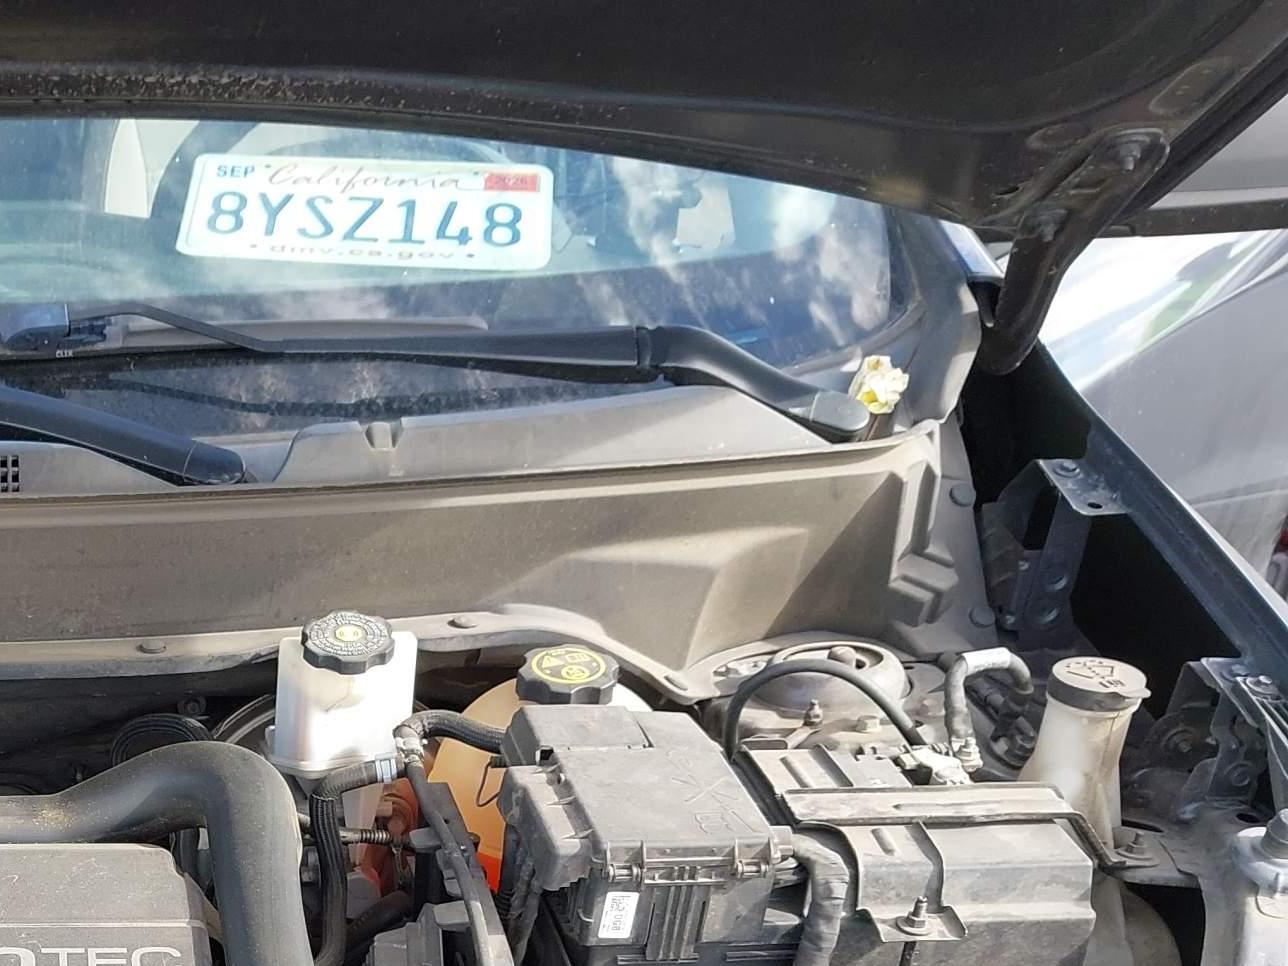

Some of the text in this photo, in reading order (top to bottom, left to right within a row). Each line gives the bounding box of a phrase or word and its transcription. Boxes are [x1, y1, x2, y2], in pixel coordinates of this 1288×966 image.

[216, 164, 461, 193] SEP California
[207, 190, 523, 248] 8YSZ148
[269, 244, 455, 261] dmv.ca.gov
